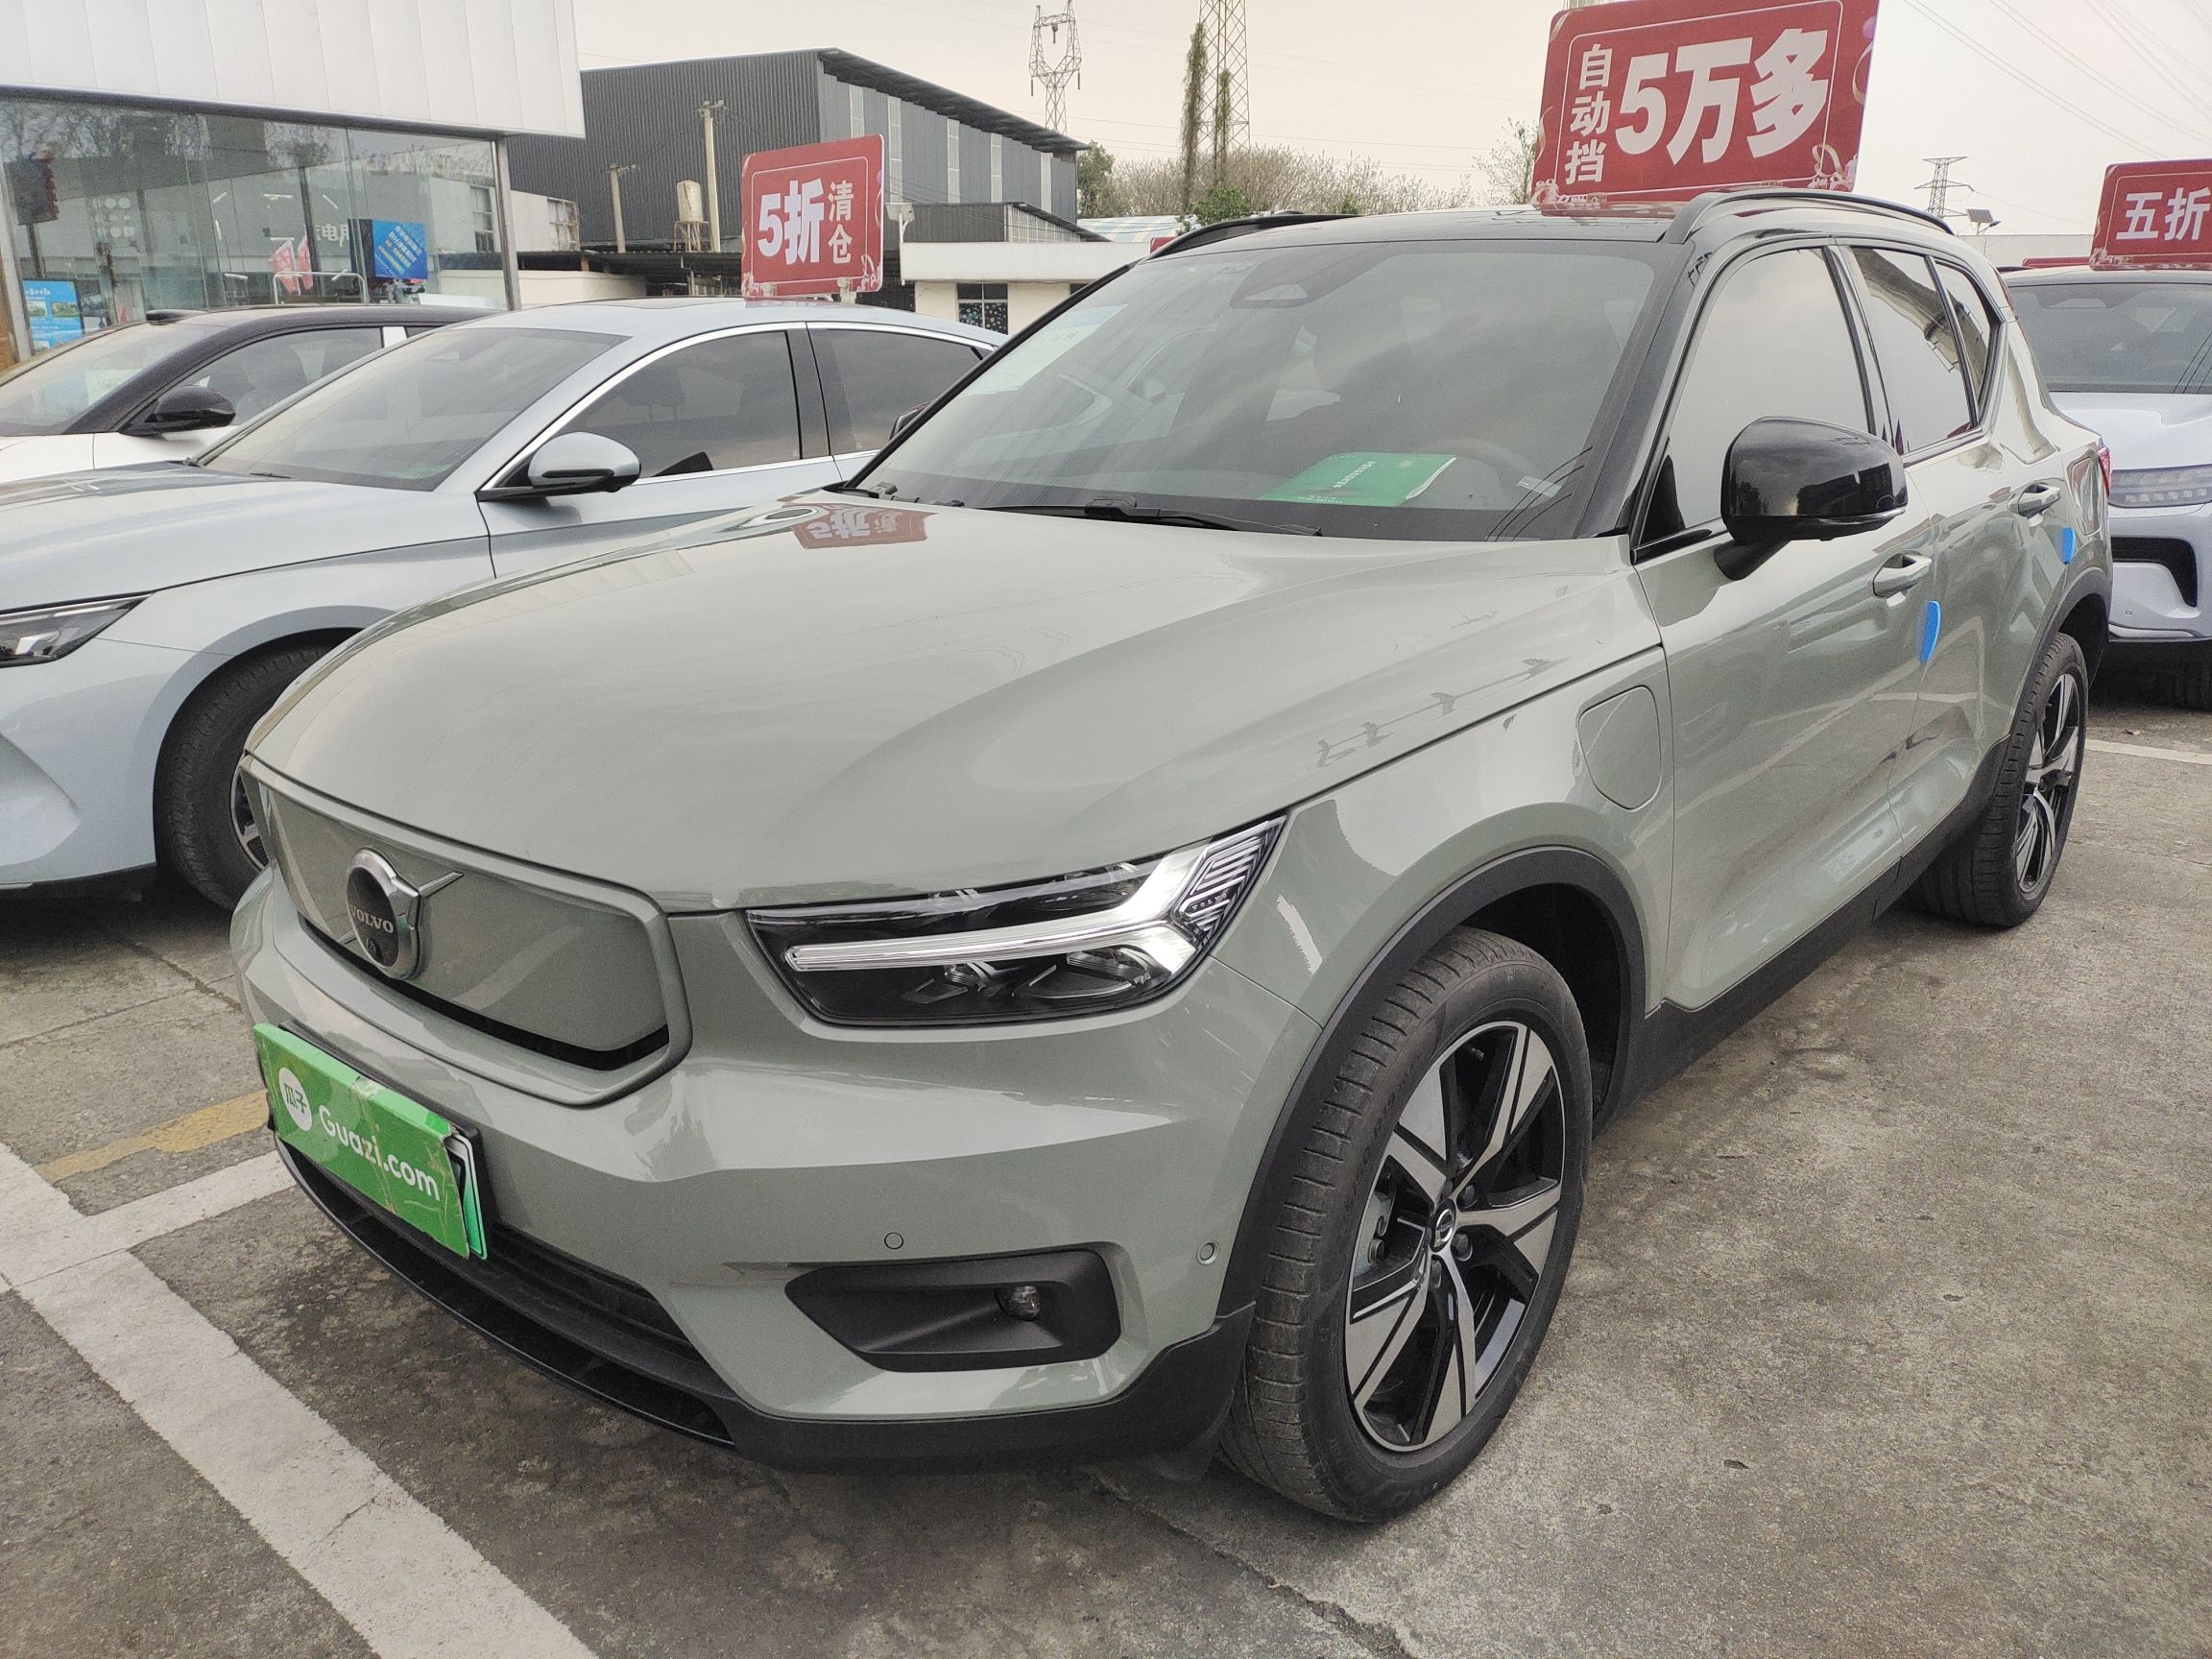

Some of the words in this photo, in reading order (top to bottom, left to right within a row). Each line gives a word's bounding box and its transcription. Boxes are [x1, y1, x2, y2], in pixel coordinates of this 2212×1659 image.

[1565, 43, 1613, 184] 自动挡
[1615, 28, 1829, 165] 5万多
[757, 178, 825, 265] 5折
[828, 180, 854, 264] 清仓
[2116, 186, 2212, 241] 五折
[350, 905, 395, 934] VOLVO
[319, 1104, 441, 1201] Guazi.com
